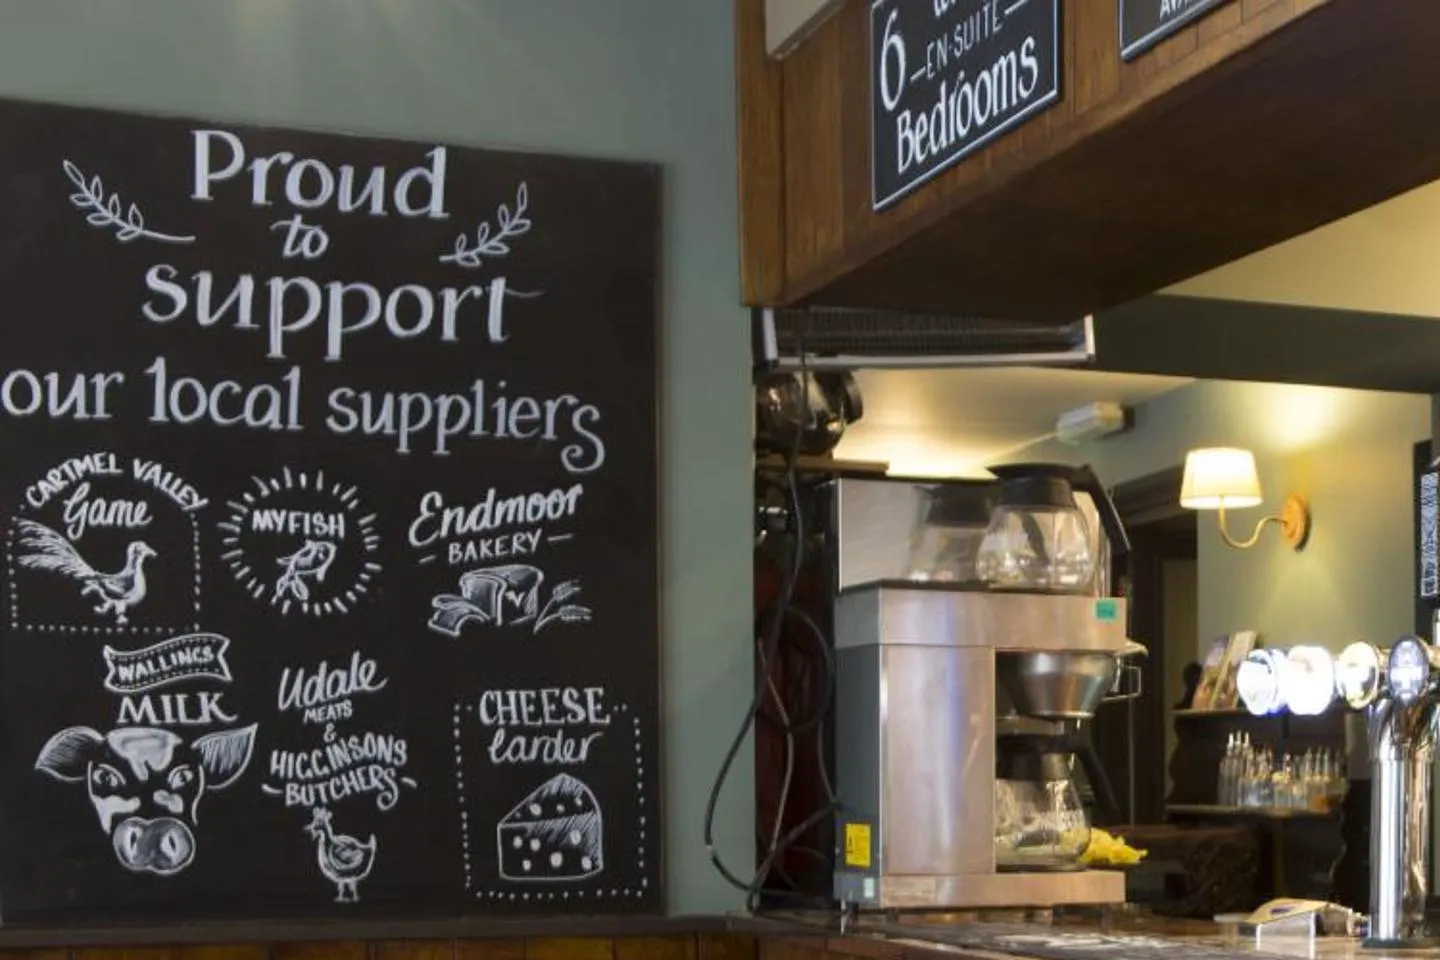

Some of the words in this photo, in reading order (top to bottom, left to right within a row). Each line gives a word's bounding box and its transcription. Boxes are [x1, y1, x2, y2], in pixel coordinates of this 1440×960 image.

[880, 8, 906, 111] 6
[896, 35, 1039, 175] Bedrooms
[190, 129, 451, 219] Proud
[271, 214, 329, 258] to
[141, 264, 520, 361] support
[1, 368, 124, 420] our
[143, 356, 304, 430] local
[326, 379, 605, 473] suppliers
[26, 452, 122, 507] CARTMEL
[133, 457, 208, 511] VALLEY
[63, 482, 152, 540] Game
[409, 483, 583, 547] Endmoor
[448, 529, 542, 564] BAKERY
[116, 692, 238, 724] MILK
[278, 650, 388, 711] Udale
[479, 687, 611, 726] CHEESE
[303, 700, 353, 724] MEATS
[323, 723, 336, 742] &
[285, 764, 399, 811] BUTCHERS
